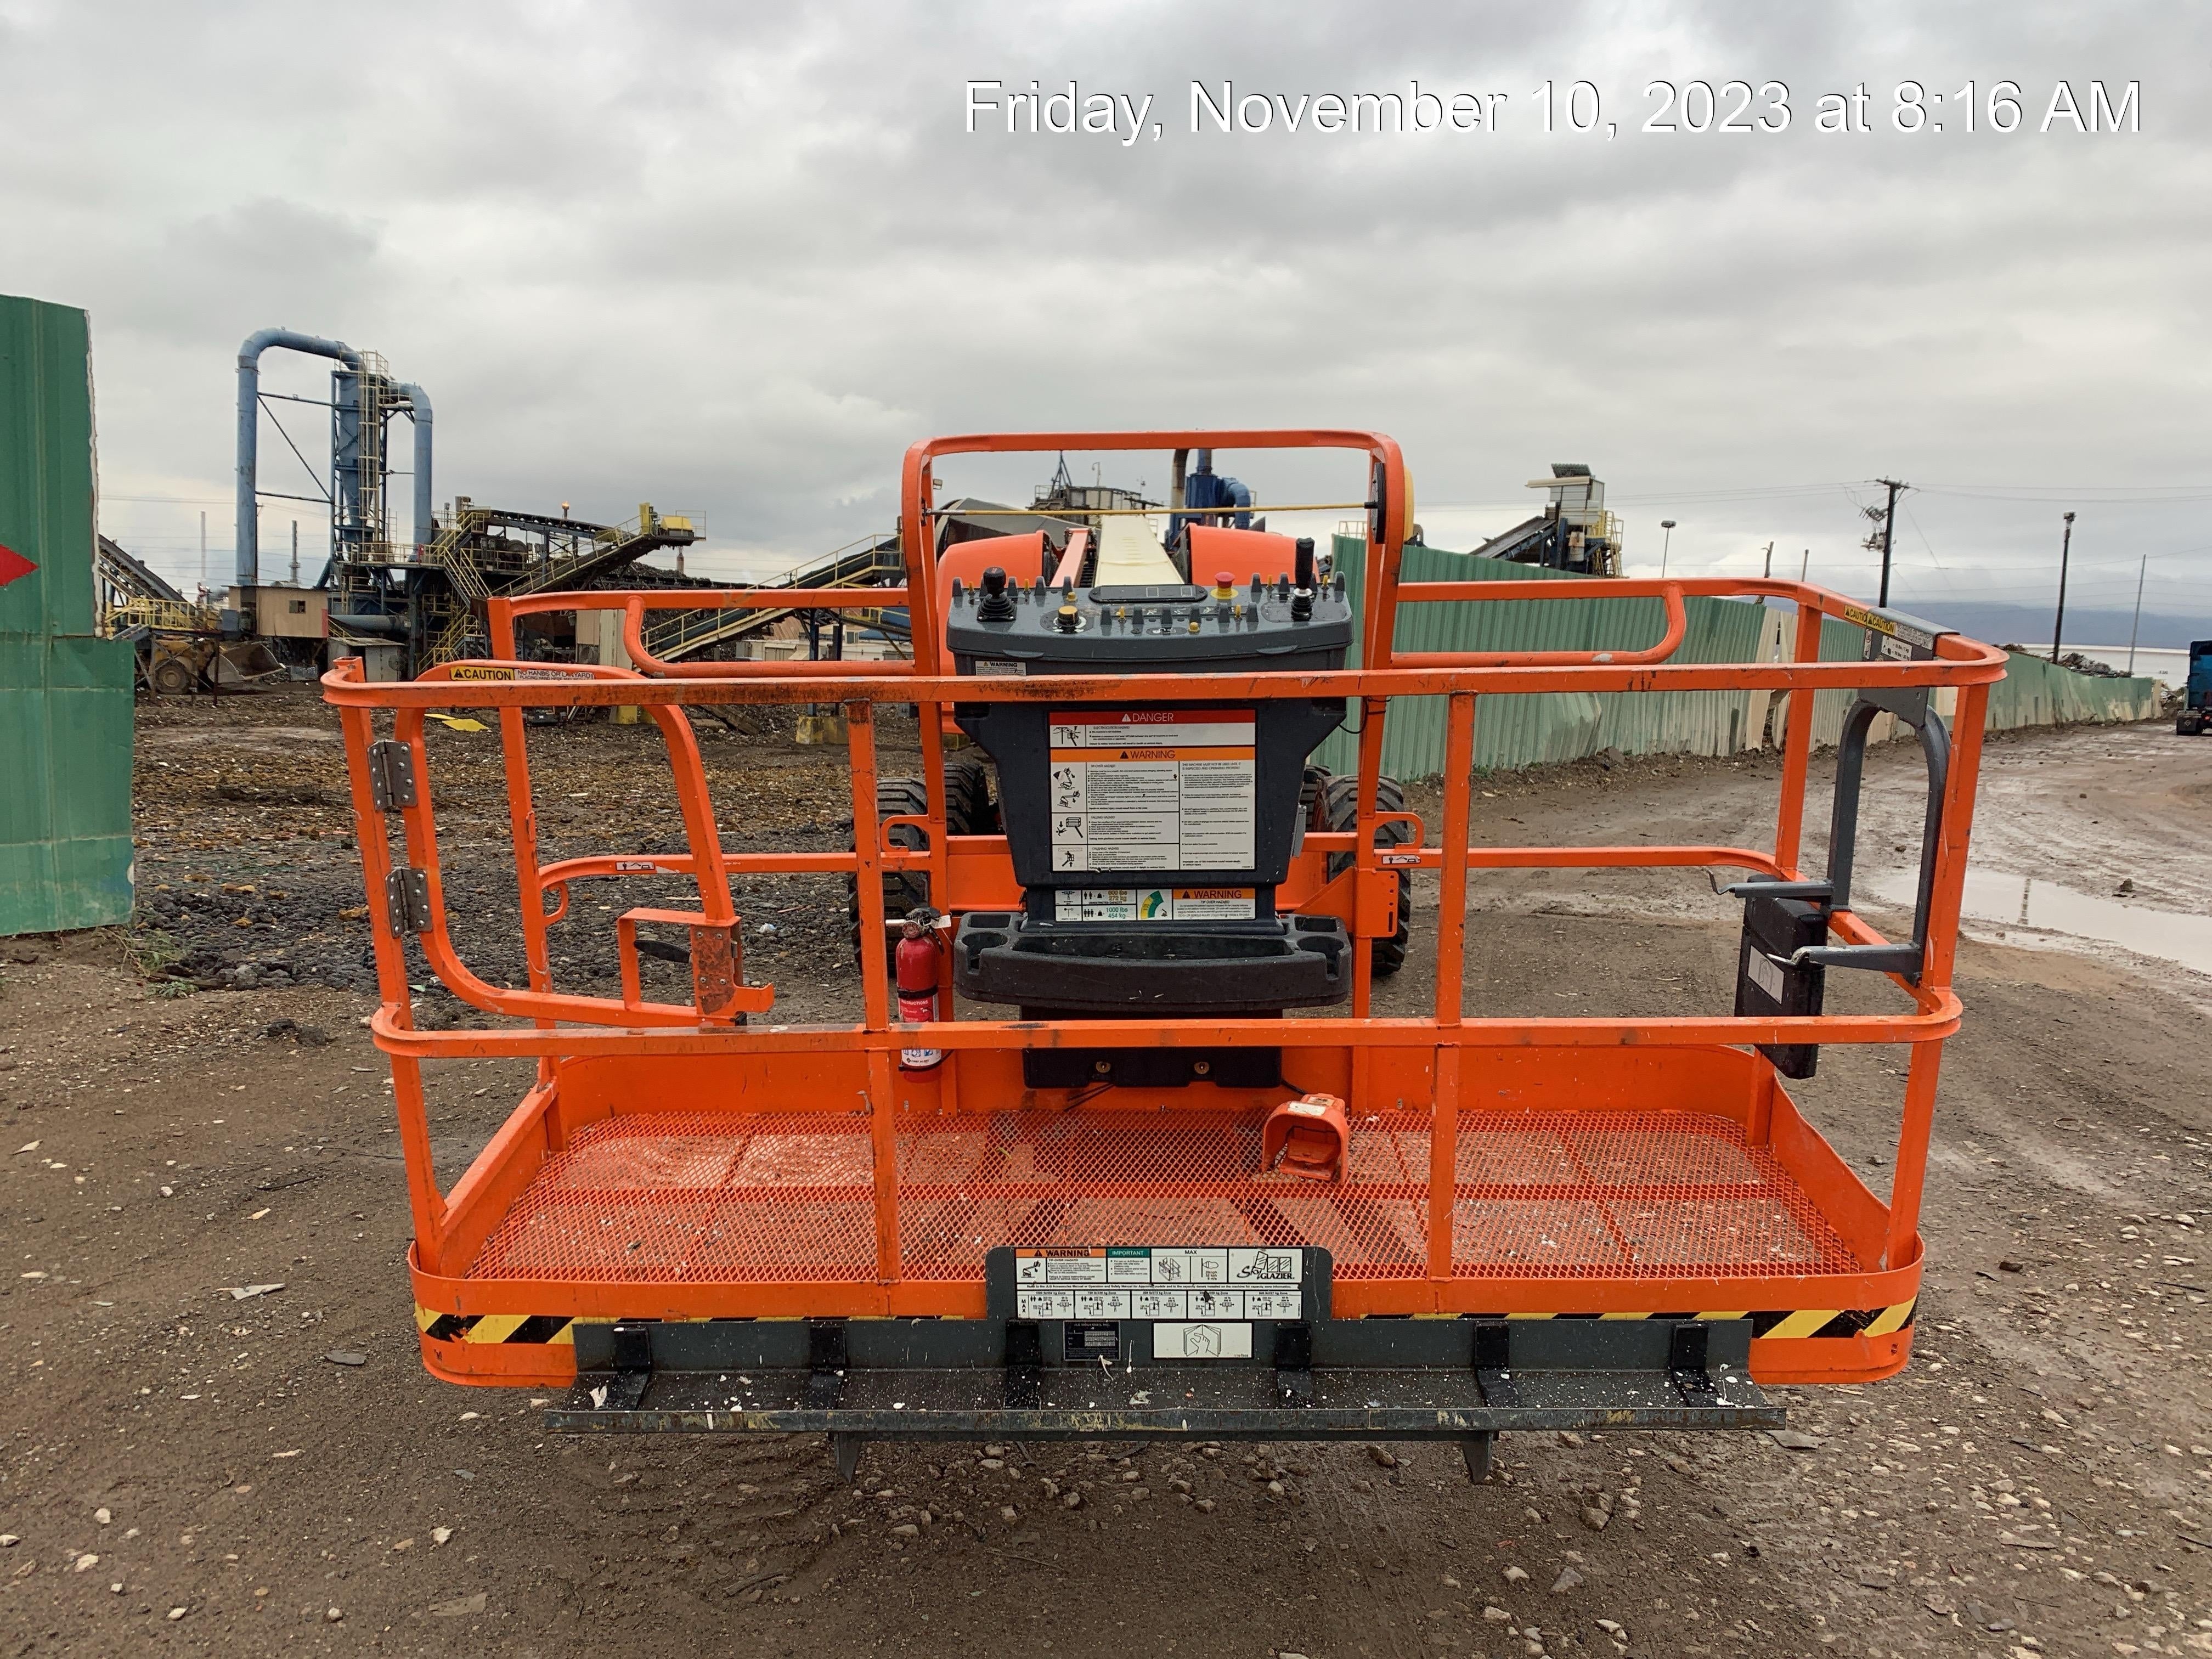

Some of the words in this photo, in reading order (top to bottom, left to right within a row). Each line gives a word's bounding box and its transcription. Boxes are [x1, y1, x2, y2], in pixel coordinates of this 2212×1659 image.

[1849, 608, 1867, 622] CAUTIO
[1872, 617, 1894, 633] CAUTION
[462, 669, 511, 680] CAUTION
[1132, 713, 1174, 723] DANGER
[1130, 750, 1176, 759] WARNING
[1194, 890, 1242, 899] WARNING
